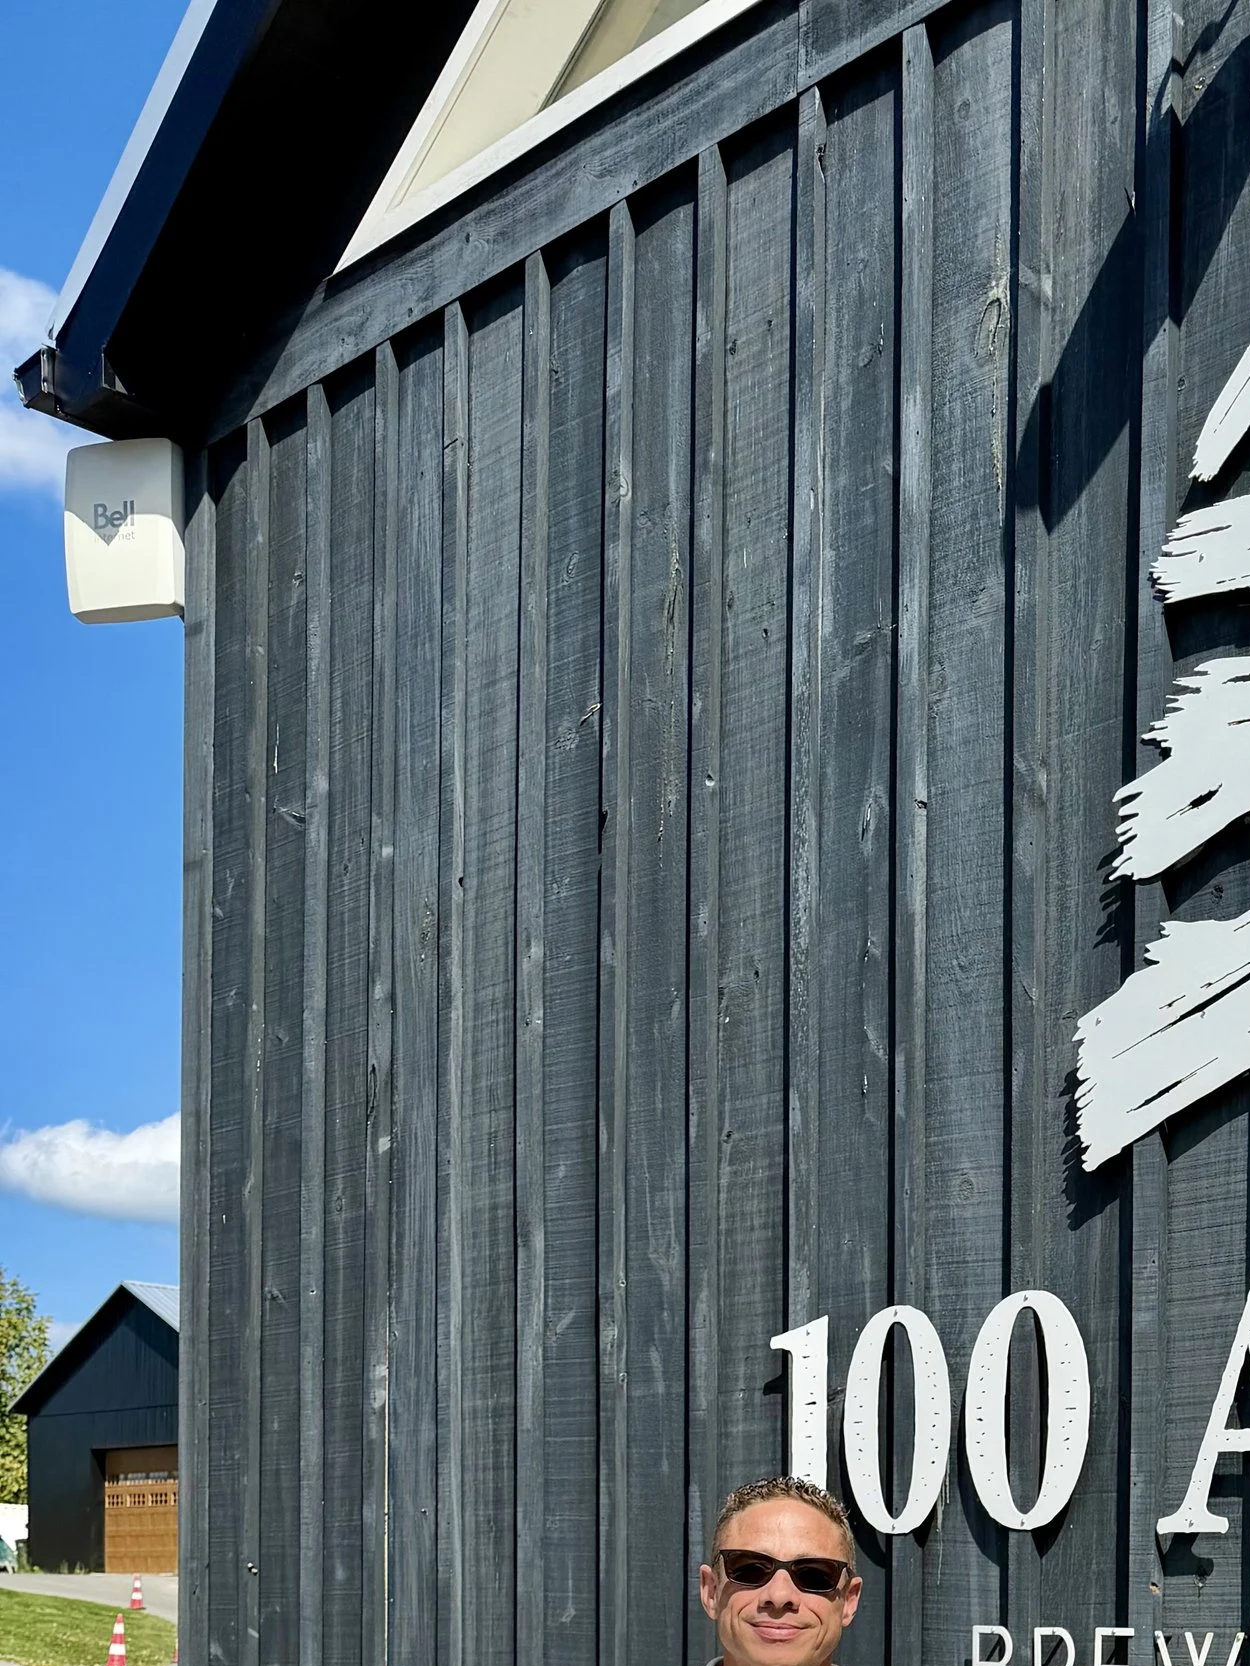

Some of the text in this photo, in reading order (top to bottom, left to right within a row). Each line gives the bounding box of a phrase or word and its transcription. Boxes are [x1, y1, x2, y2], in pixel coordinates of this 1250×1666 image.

[94, 500, 134, 529] Bell
[94, 531, 135, 544] Itenet
[769, 1290, 1091, 1534] 100
